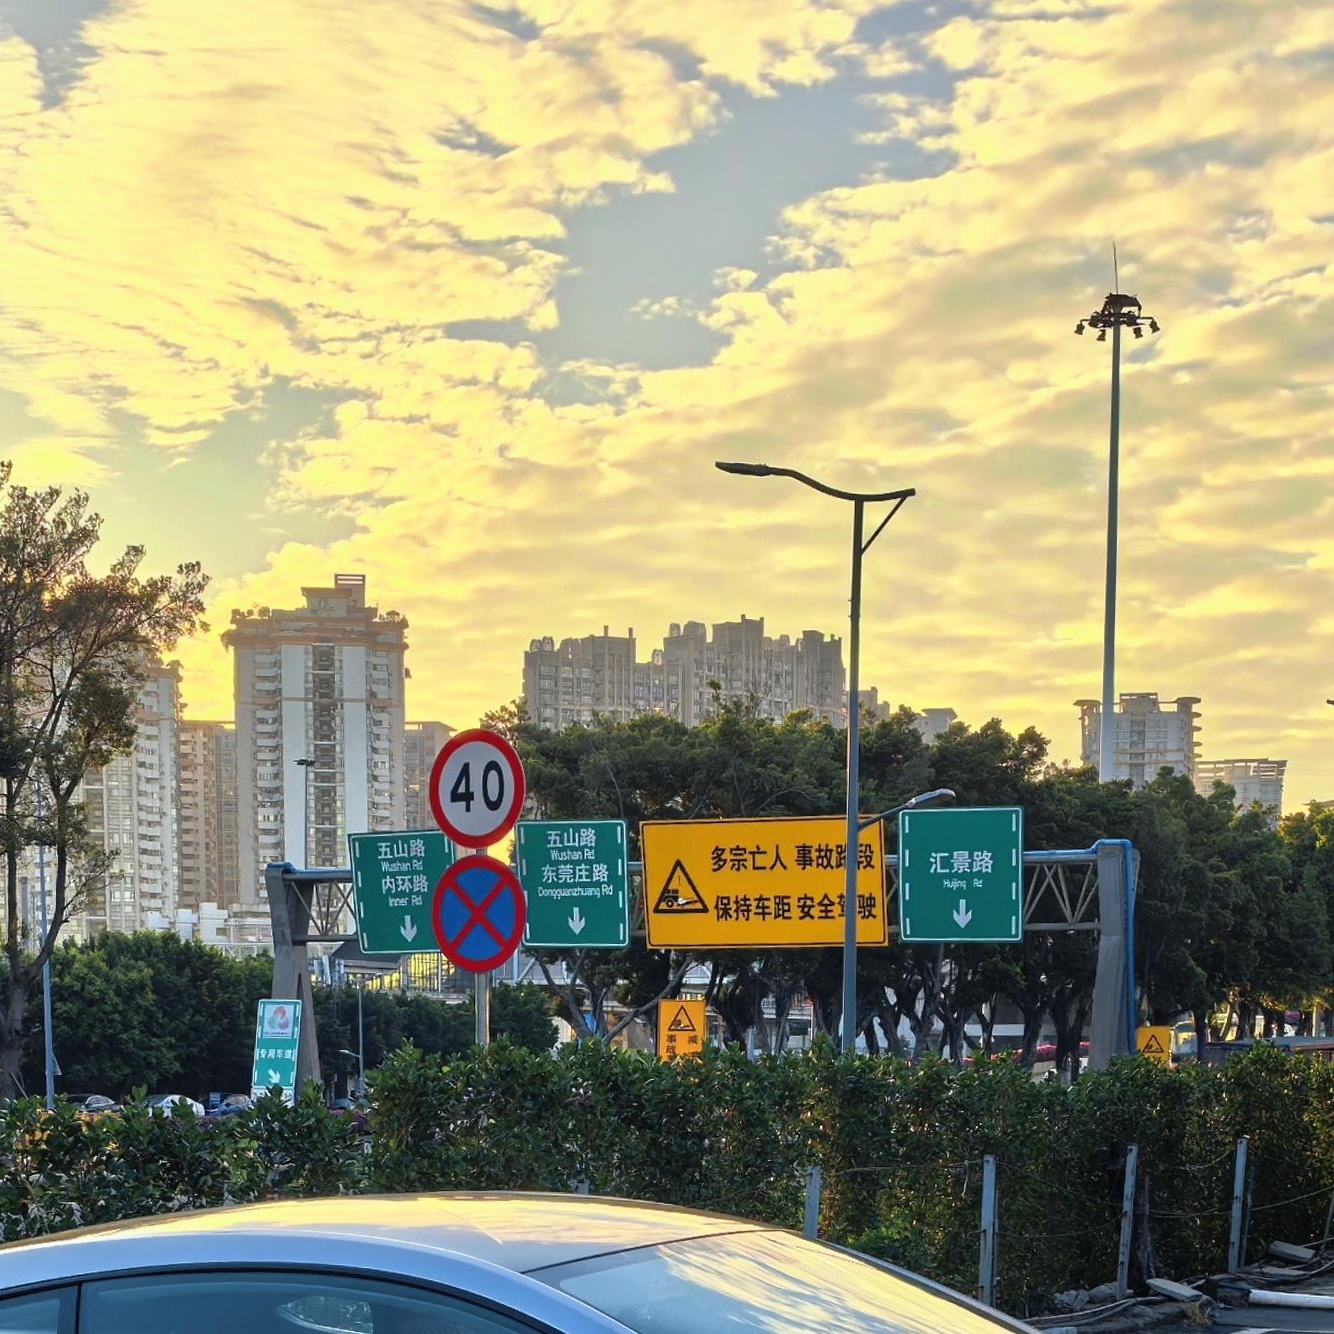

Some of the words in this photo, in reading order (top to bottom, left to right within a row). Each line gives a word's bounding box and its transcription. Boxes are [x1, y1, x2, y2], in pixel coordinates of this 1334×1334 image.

[450, 760, 505, 813] 40
[546, 827, 597, 848] 五山路
[377, 838, 425, 859] 五山路
[550, 848, 583, 861] Wushan
[584, 848, 596, 860] Rd
[711, 844, 788, 873] 多宗亡人
[381, 860, 411, 872] Wushan
[412, 859, 424, 871] Rd
[930, 850, 994, 873] 汇景路
[541, 863, 609, 883] 东莞庄路
[381, 874, 429, 895] 内环路
[601, 883, 613, 896] Rd
[713, 894, 793, 923] 保持车距
